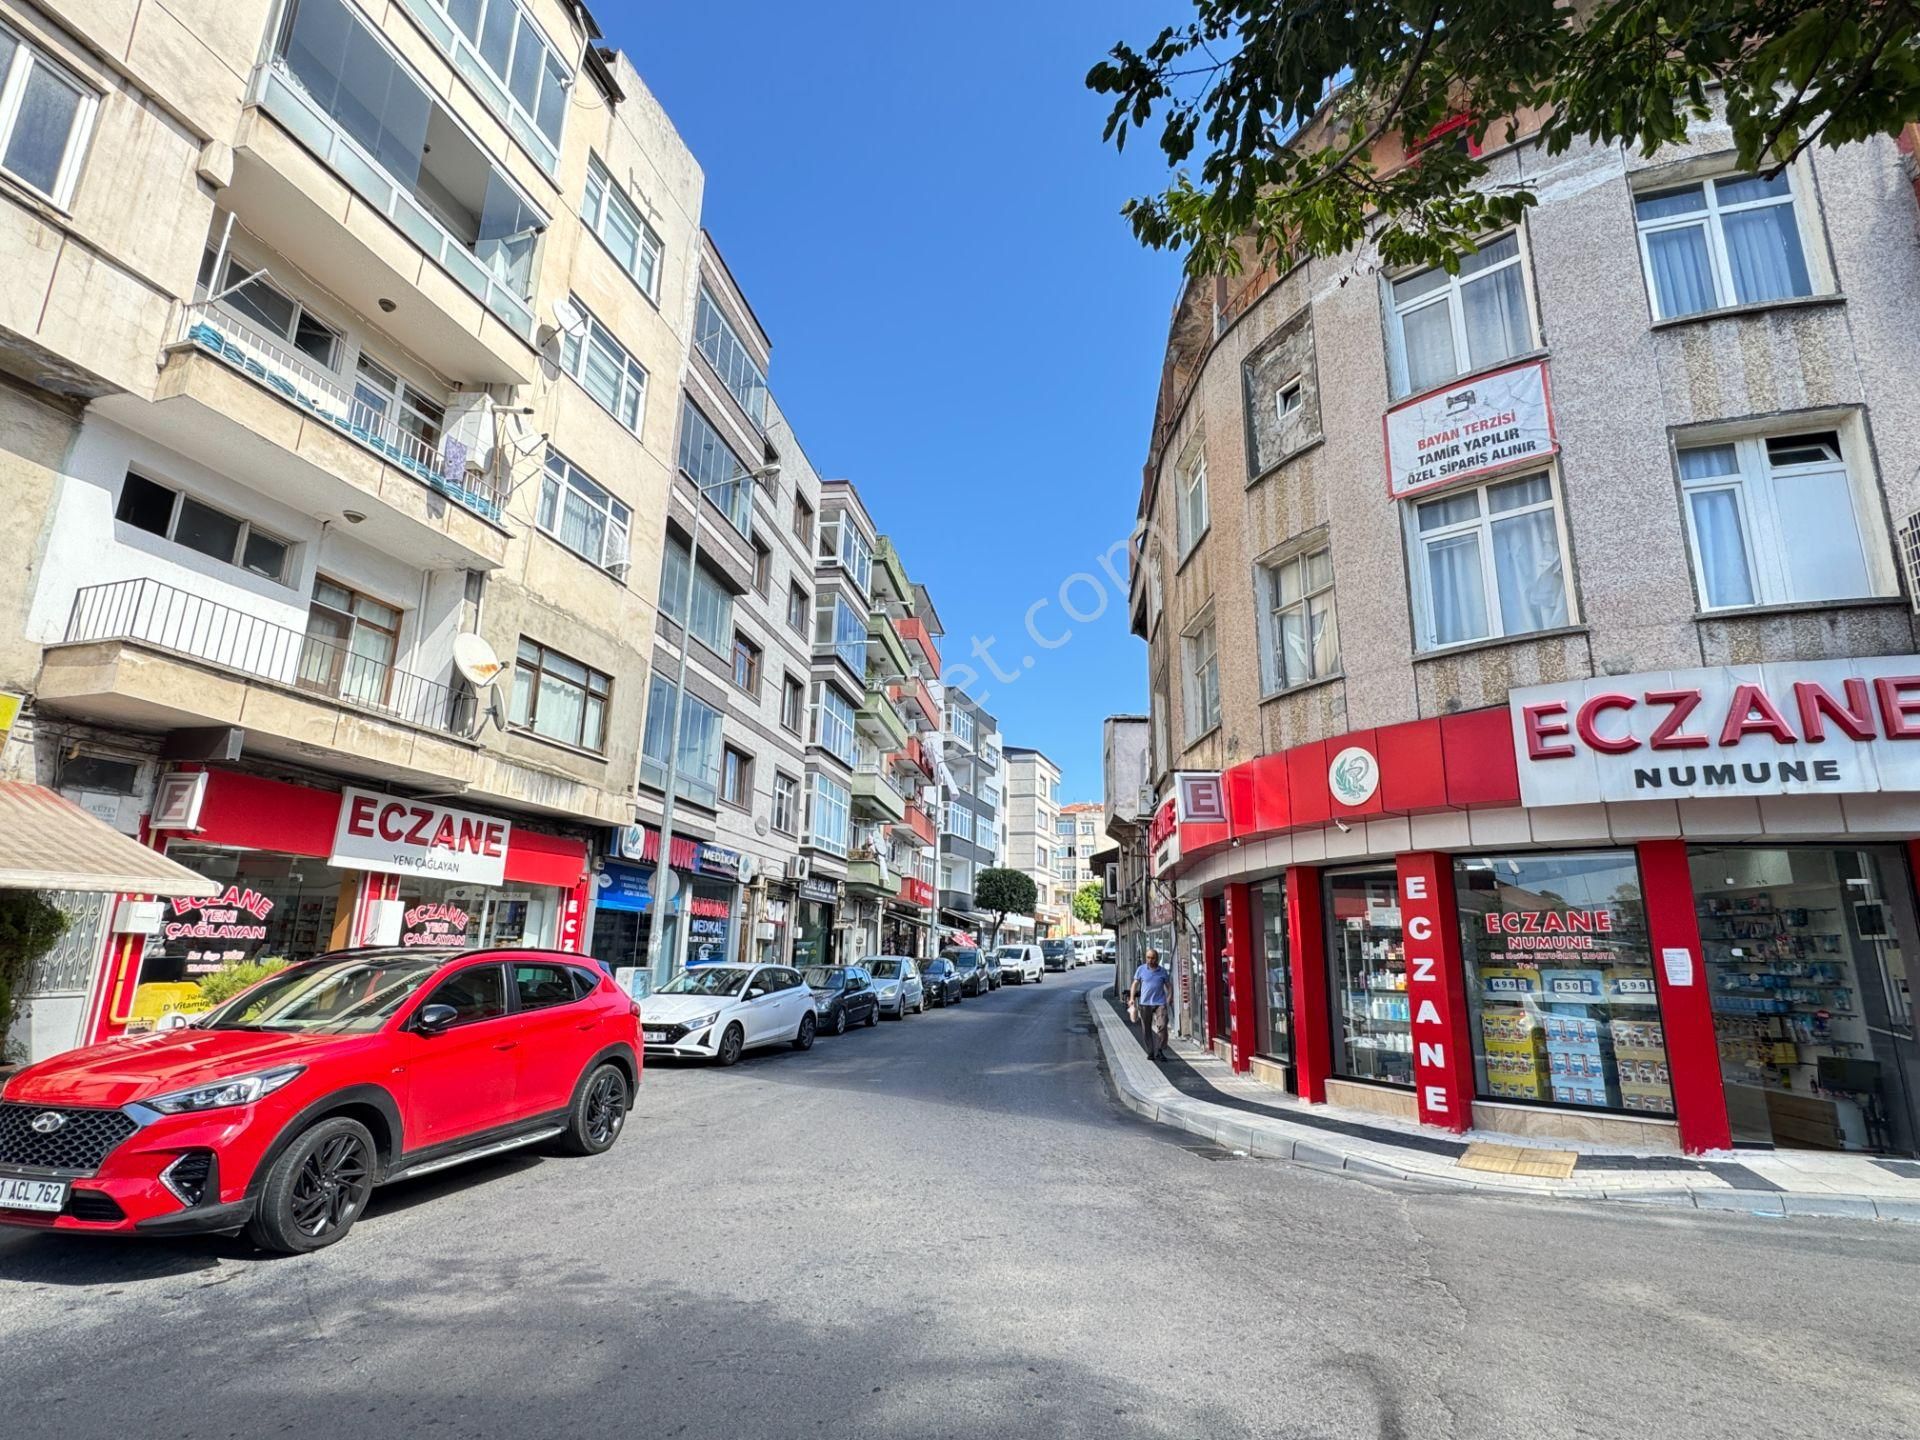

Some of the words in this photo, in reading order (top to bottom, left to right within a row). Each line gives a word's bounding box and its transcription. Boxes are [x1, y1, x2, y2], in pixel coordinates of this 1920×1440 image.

[1417, 426, 1460, 451] BAYAN
[1463, 410, 1516, 435] TERZİSİ
[1417, 443, 1460, 467] TAMİR
[1463, 427, 1520, 453] YAPILIR
[1407, 464, 1436, 486] ÖZEL
[1439, 452, 1489, 476] SİPARİŞ
[1492, 440, 1536, 460] ALINIR
[1523, 677, 1920, 761] ECZANE
[1634, 759, 1842, 789] NUMUNE
[1190, 783, 1216, 813] E
[347, 795, 505, 857] ECZANE
[643, 828, 698, 871] NUUNE
[703, 848, 739, 868] MEDİKAL
[415, 857, 460, 874] ÇAĞLAYAN
[165, 920, 266, 940] ÇAĞLAYAN
[405, 903, 469, 930] ECZANE
[1486, 910, 1613, 933] ECZANE
[1508, 936, 1592, 949] NUMUNE
[1227, 899, 1239, 1062] ECZANE
[1405, 876, 1449, 1113] ECZANE
[1494, 980, 1515, 989] 499
[1556, 981, 1579, 990] 850
[1621, 981, 1646, 990] 599
[9, 1181, 30, 1201] ACL
[35, 1183, 61, 1203] 762
